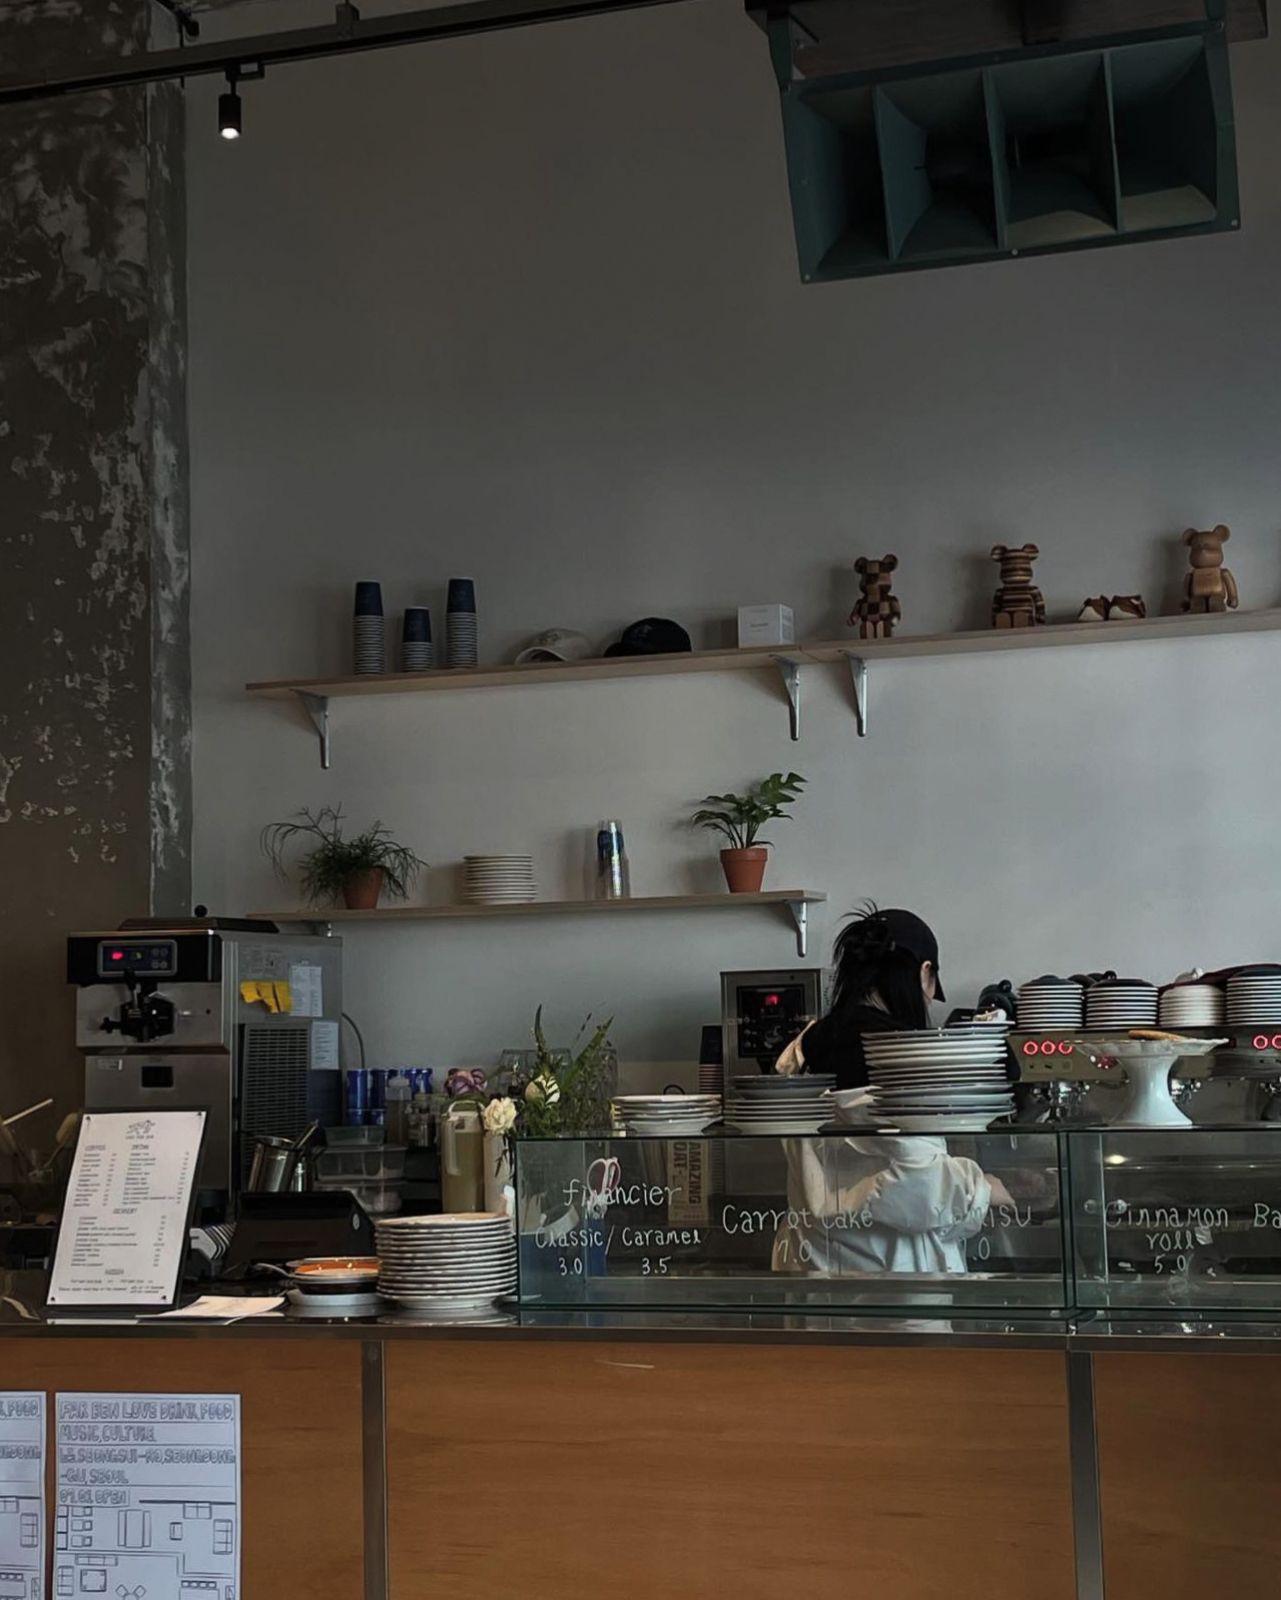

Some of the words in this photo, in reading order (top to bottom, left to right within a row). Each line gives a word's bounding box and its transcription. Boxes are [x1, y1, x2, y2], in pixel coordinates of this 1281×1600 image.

[722, 1204, 813, 1234] Carrot
[777, 1239, 812, 1263] 7.0
[1146, 1230, 1195, 1251] roll
[558, 1257, 582, 1277] 3.0
[642, 1256, 671, 1275] 3.5
[1154, 1254, 1187, 1275] 5.0
